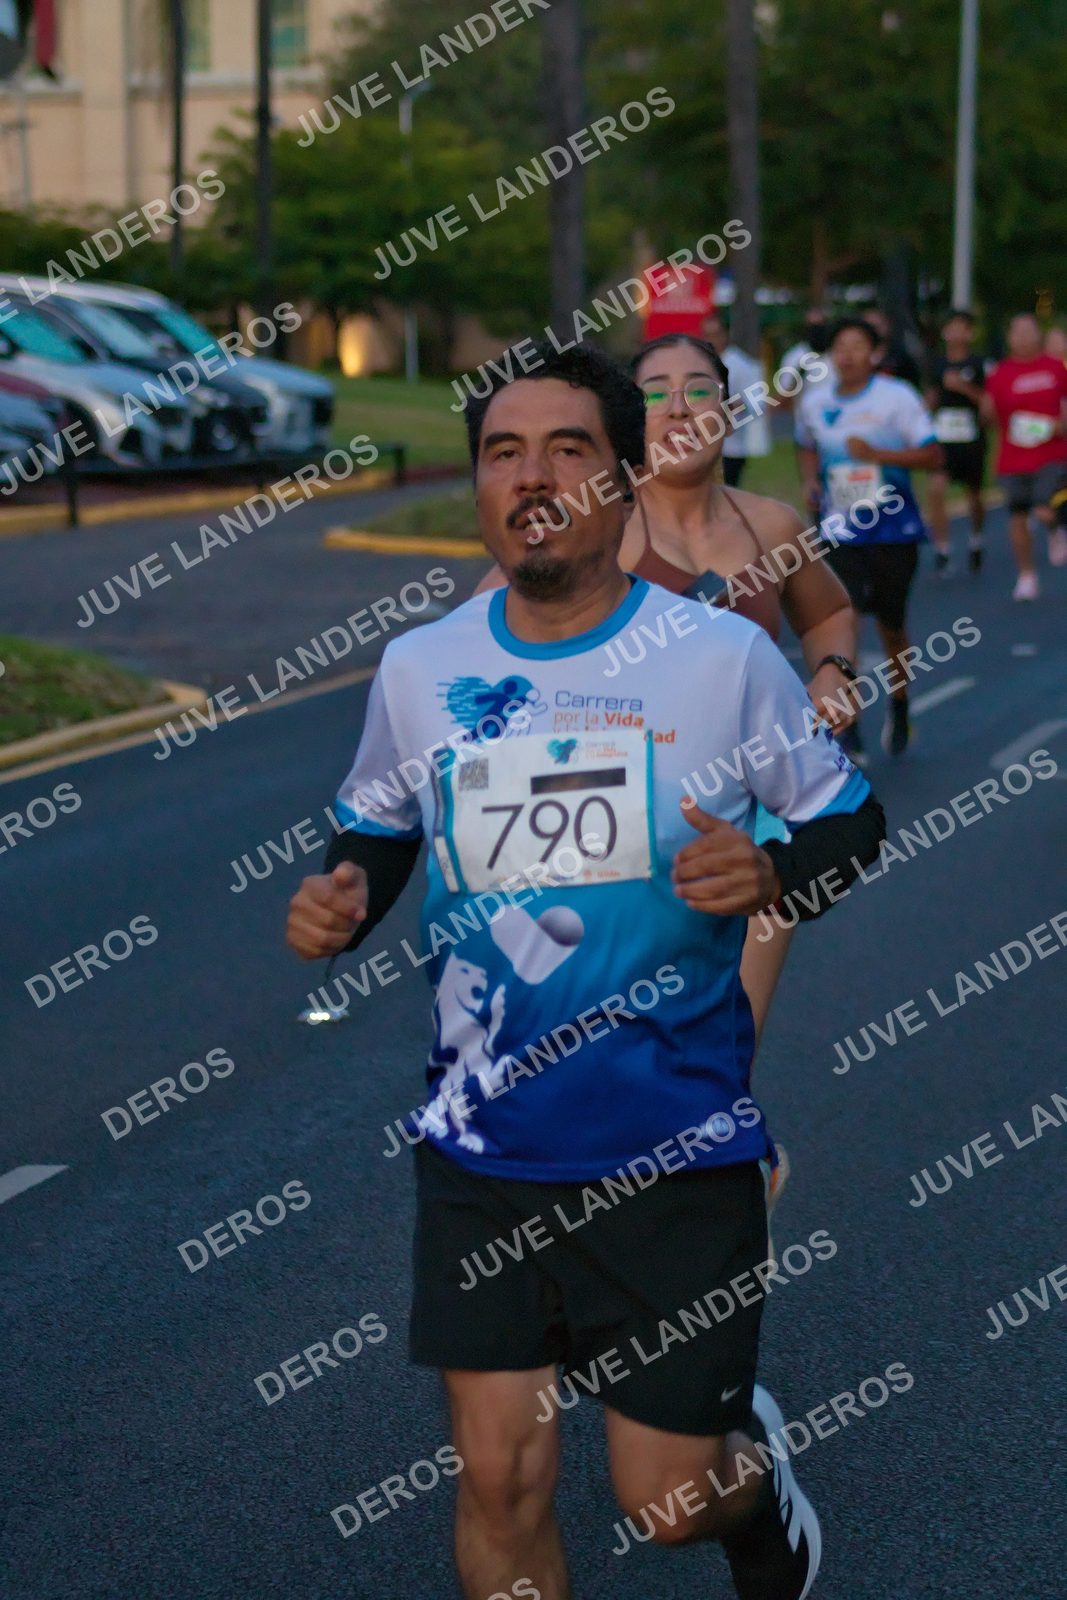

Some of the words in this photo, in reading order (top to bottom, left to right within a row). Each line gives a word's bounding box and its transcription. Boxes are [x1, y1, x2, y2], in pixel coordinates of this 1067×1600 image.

[555, 690, 643, 712] Carrera
[553, 710, 580, 728] por
[585, 709, 599, 725] la
[604, 712, 645, 730] Vida
[481, 796, 618, 870] 790
